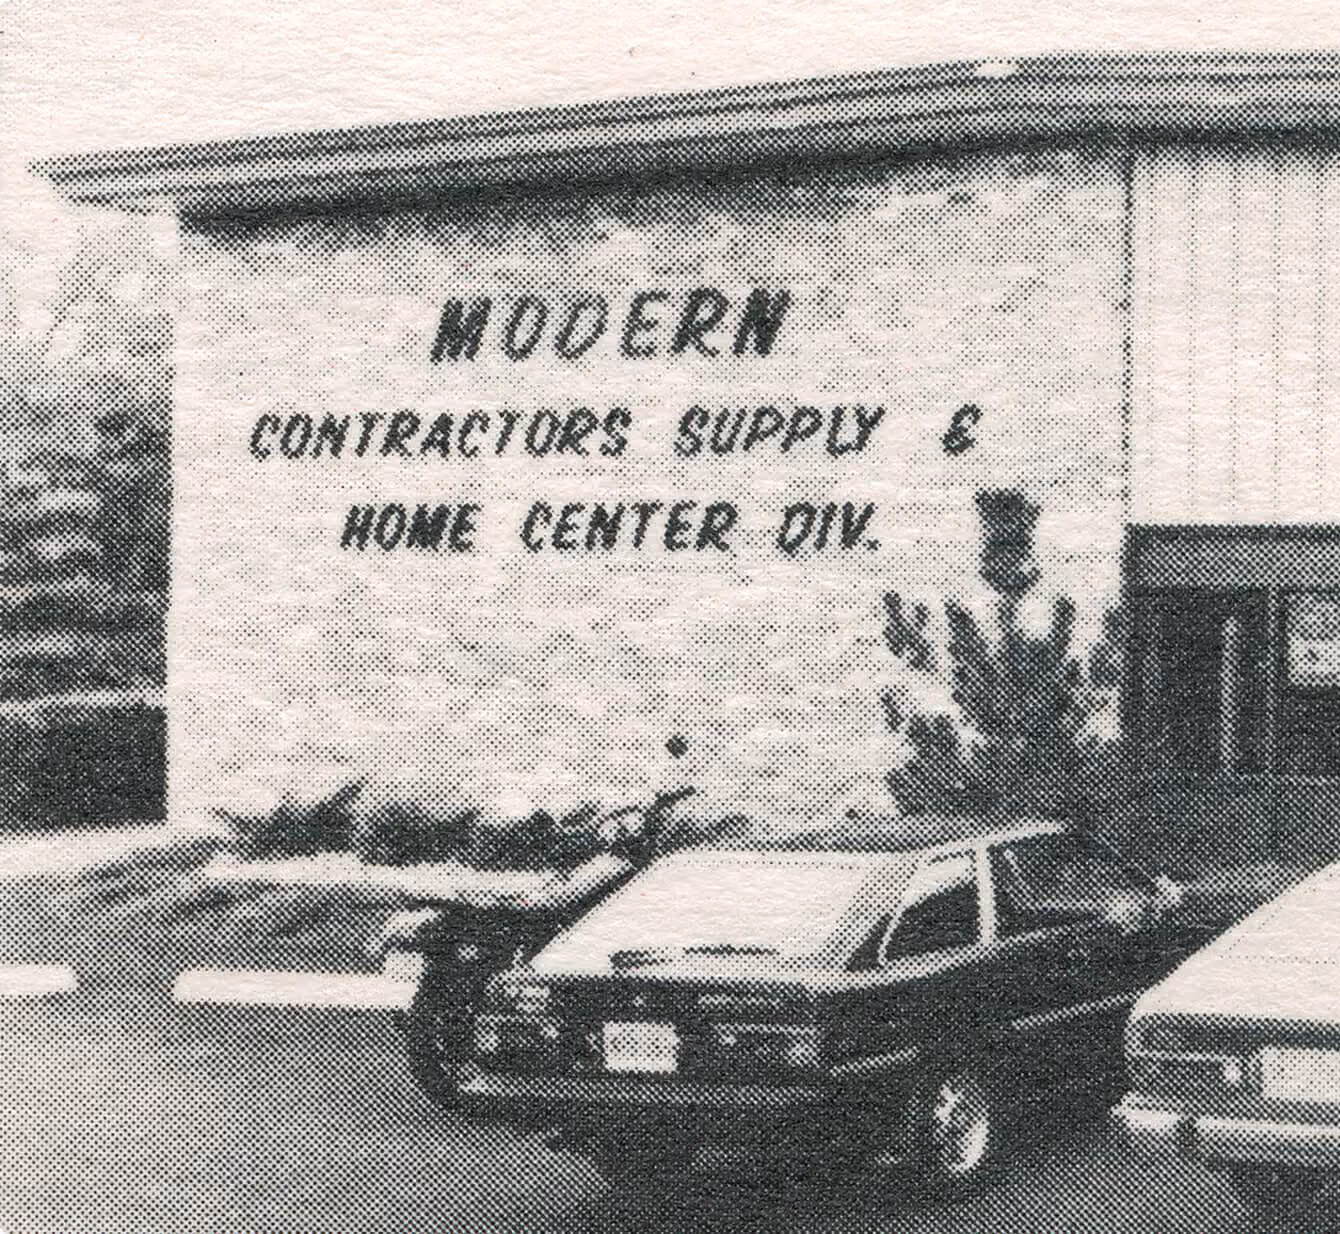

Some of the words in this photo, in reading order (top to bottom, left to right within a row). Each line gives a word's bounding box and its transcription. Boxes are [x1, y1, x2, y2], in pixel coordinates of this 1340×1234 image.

[429, 288, 793, 364] MODERN
[249, 406, 632, 460] CONTRACTORS
[673, 405, 886, 458] SUPPLY
[941, 404, 984, 458] &
[340, 502, 482, 553] HOME
[519, 501, 740, 554] CENTER
[775, 501, 880, 553] DIV.
